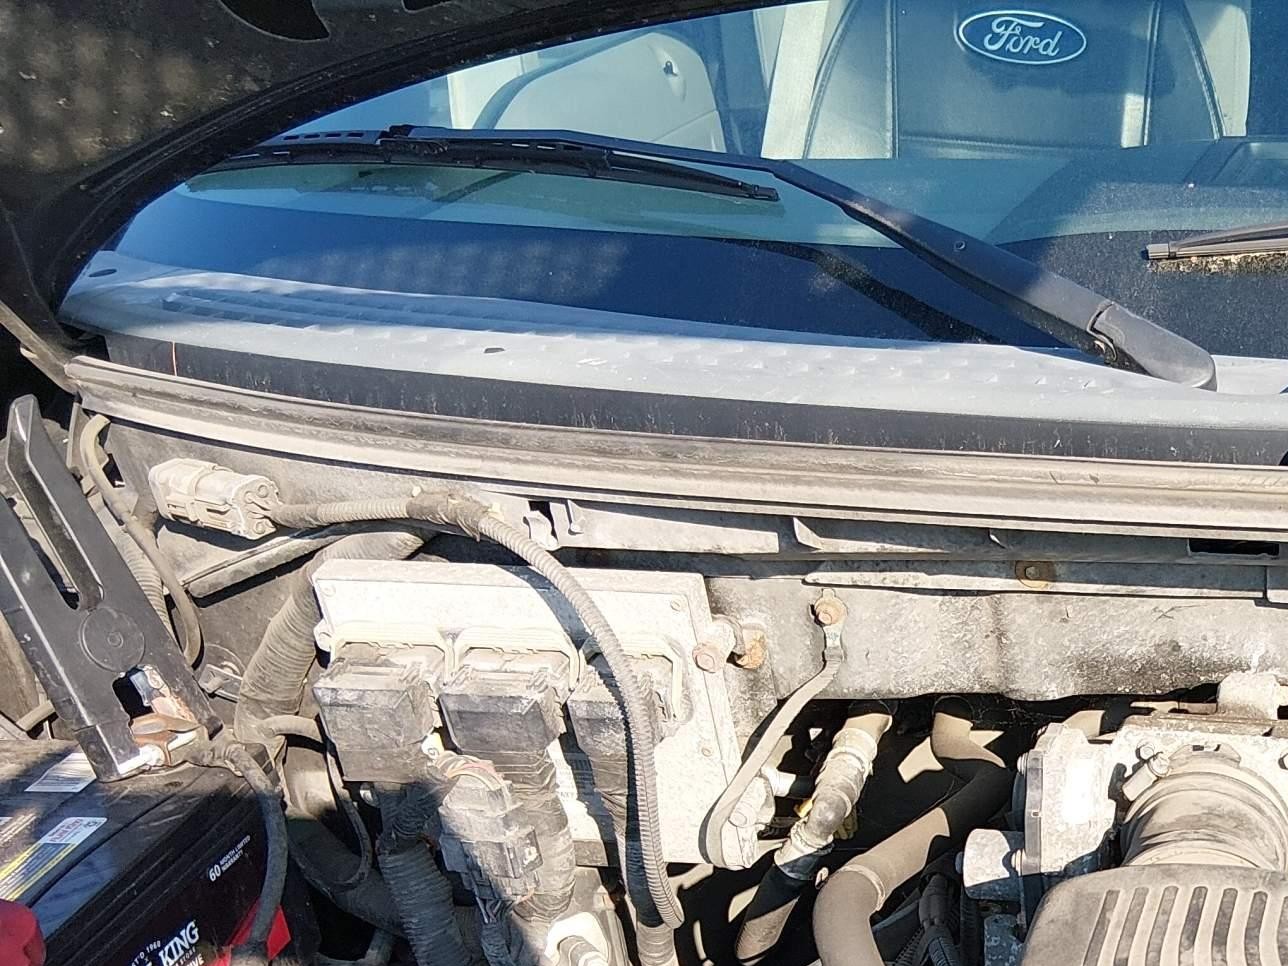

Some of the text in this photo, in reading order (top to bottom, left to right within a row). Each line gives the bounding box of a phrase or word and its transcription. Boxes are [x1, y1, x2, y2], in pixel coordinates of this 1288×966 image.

[983, 16, 1063, 57] Ford
[210, 864, 221, 882] 60
[179, 947, 197, 965] STORE
